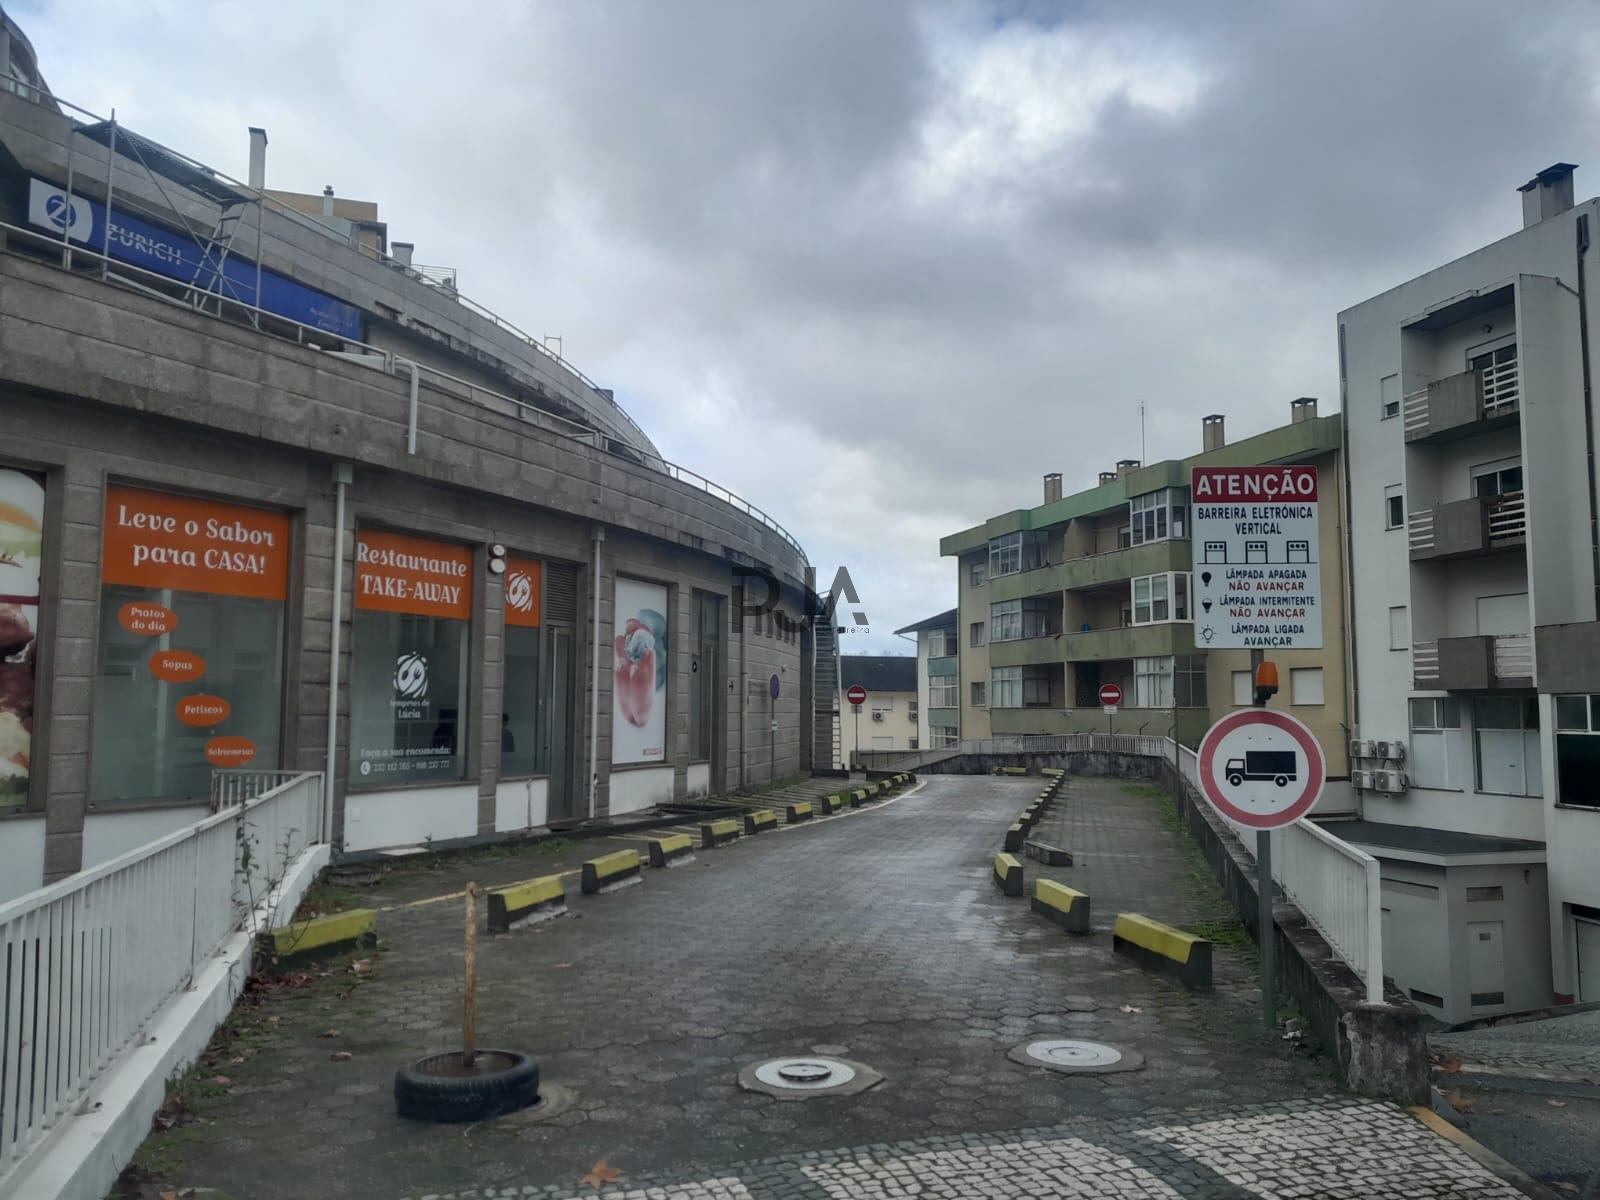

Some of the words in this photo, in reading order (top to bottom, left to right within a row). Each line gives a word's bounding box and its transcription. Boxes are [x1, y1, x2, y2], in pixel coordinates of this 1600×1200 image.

[106, 222, 181, 265] ZURICH
[1196, 468, 1314, 501] ATENÇÃO
[1198, 506, 1247, 519] BARREIRA
[1252, 504, 1313, 519] ELETRÓNICA
[118, 504, 176, 533] Leve
[184, 519, 199, 536] o
[206, 518, 274, 547] Sabor
[1235, 522, 1282, 535] VERTICAL
[133, 543, 197, 567] para
[204, 548, 266, 574] CASA!
[357, 542, 467, 577] Restaurante
[1225, 568, 1266, 579] LÂMPADA
[1269, 569, 1307, 579] APAGADA
[361, 574, 461, 605] TAKE-AWAY
[1229, 580, 1251, 591] NÃO
[1256, 581, 1305, 593] AVANÇAR
[1219, 595, 1255, 606] LÂMPADA
[1259, 596, 1315, 606] INTERMITENTE
[131, 607, 165, 618] Pratos
[1230, 606, 1252, 617] NÃO
[1257, 608, 1306, 620] AVANÇAR
[131, 619, 145, 629] do
[148, 620, 166, 631] dia
[1231, 622, 1270, 634] LÂMPADA
[1275, 625, 1305, 634] LIGADA
[1244, 636, 1293, 648] AVANÇAR
[162, 659, 193, 671] Sopas
[185, 704, 224, 715] Petiscos
